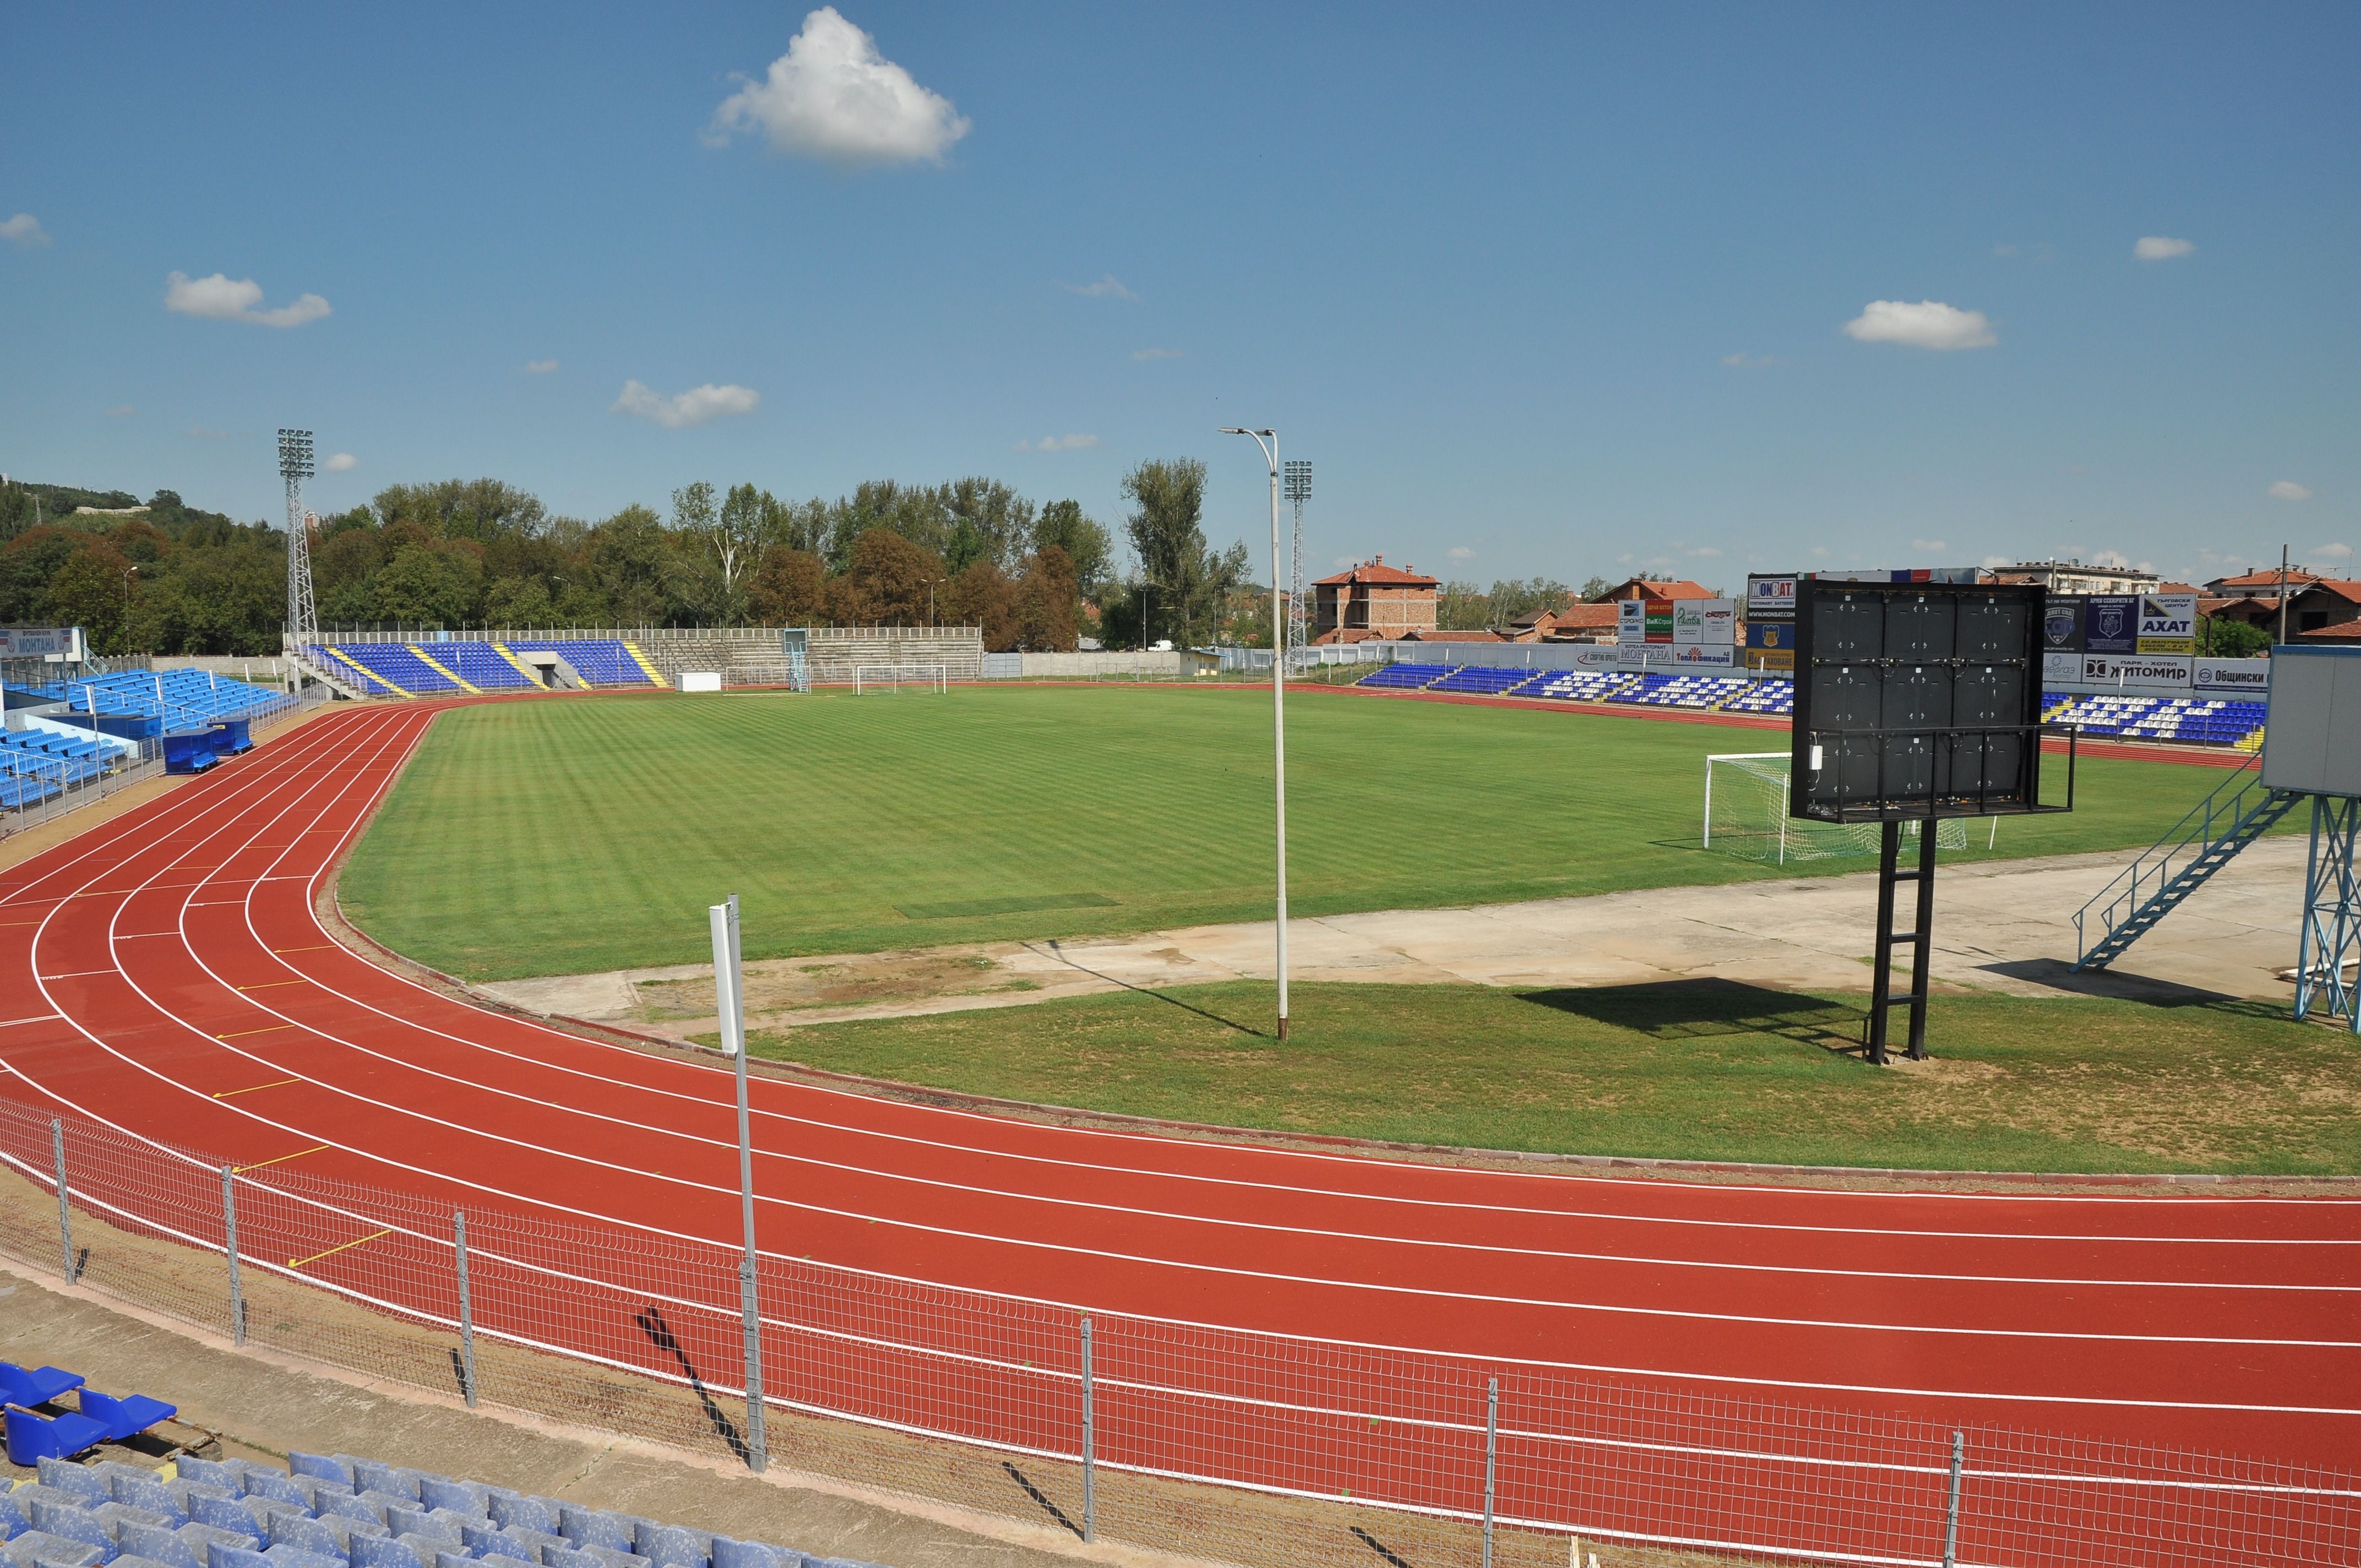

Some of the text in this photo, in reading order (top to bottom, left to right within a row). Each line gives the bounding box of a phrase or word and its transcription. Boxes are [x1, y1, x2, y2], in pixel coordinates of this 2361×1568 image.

[1751, 582, 1792, 597] MONBAT
[2142, 621, 2190, 632] АХАТ
[19, 638, 55, 653] МОНТАНА
[1621, 649, 1670, 660] МОНТАНА
[1677, 653, 1730, 663] Топлофикация
[1749, 652, 1792, 665] ЗАСРАХОВАНЕ
[2110, 666, 2187, 680] ЖИТОМИР
[2216, 670, 2264, 683] Общински
